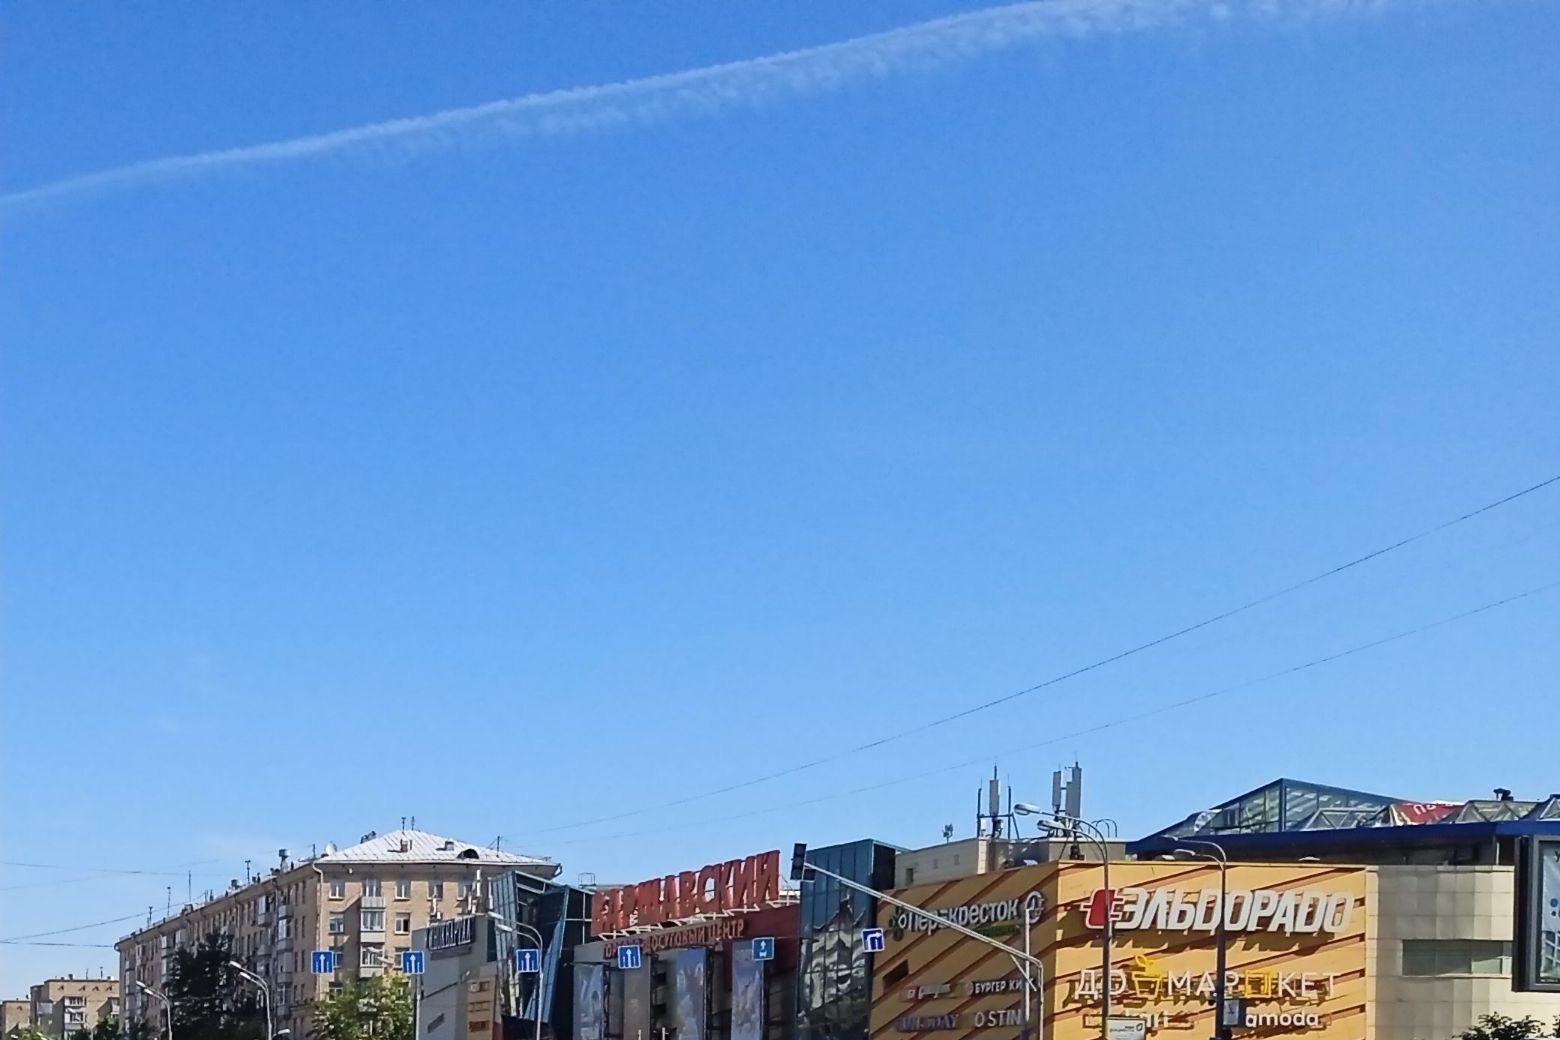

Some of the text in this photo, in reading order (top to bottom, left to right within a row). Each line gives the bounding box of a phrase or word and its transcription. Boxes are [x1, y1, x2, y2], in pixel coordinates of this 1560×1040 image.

[591, 850, 780, 935] ВАРШАВСКИЙ
[1113, 888, 1356, 936] ЭЛЬДОРАДО
[708, 918, 744, 941] ЦЕНТР
[975, 981, 1006, 993] БУРГЕР
[1245, 1012, 1318, 1027] amoda
